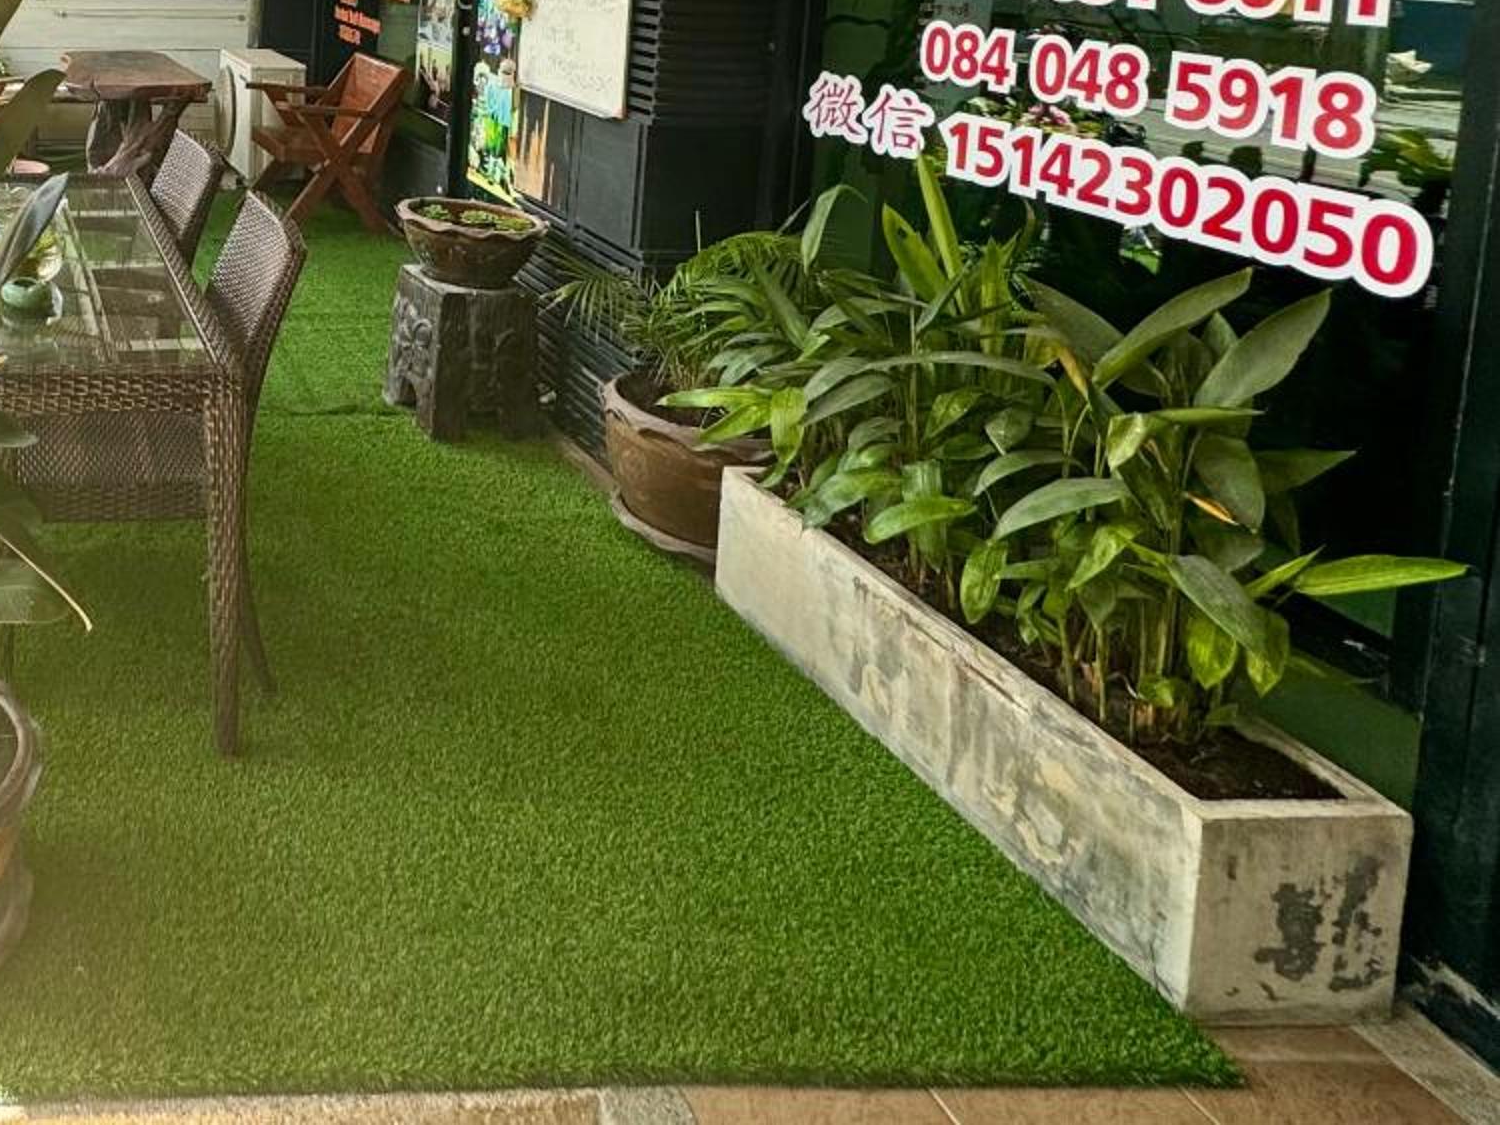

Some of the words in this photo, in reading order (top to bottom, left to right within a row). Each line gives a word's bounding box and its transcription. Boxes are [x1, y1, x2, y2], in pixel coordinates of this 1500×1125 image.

[924, 24, 1013, 87] 084
[1032, 40, 1143, 112] 048
[1170, 57, 1367, 152] 5918
[809, 80, 927, 149] 微信
[946, 119, 1421, 287] 15142302050
